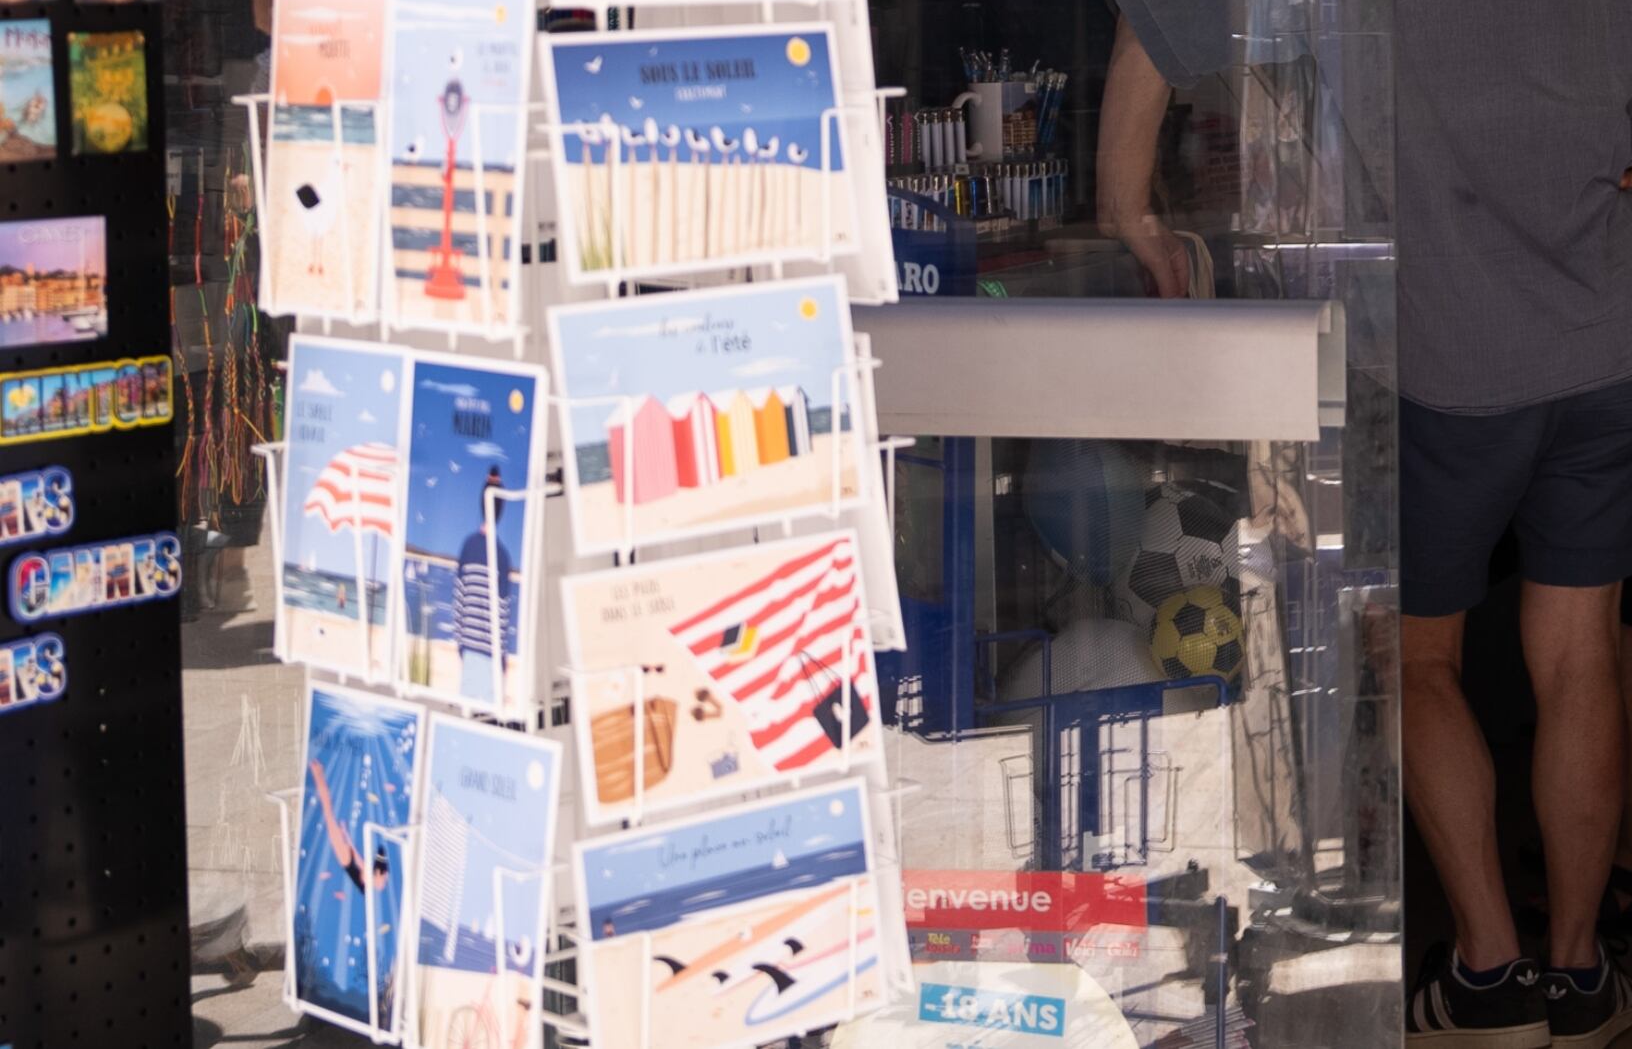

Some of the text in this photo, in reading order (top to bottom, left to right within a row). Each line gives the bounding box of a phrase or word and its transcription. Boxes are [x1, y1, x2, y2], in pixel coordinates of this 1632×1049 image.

[640, 61, 680, 85] SOUS
[17, 533, 182, 619] CANNES
[986, 997, 1059, 1032] ANS
